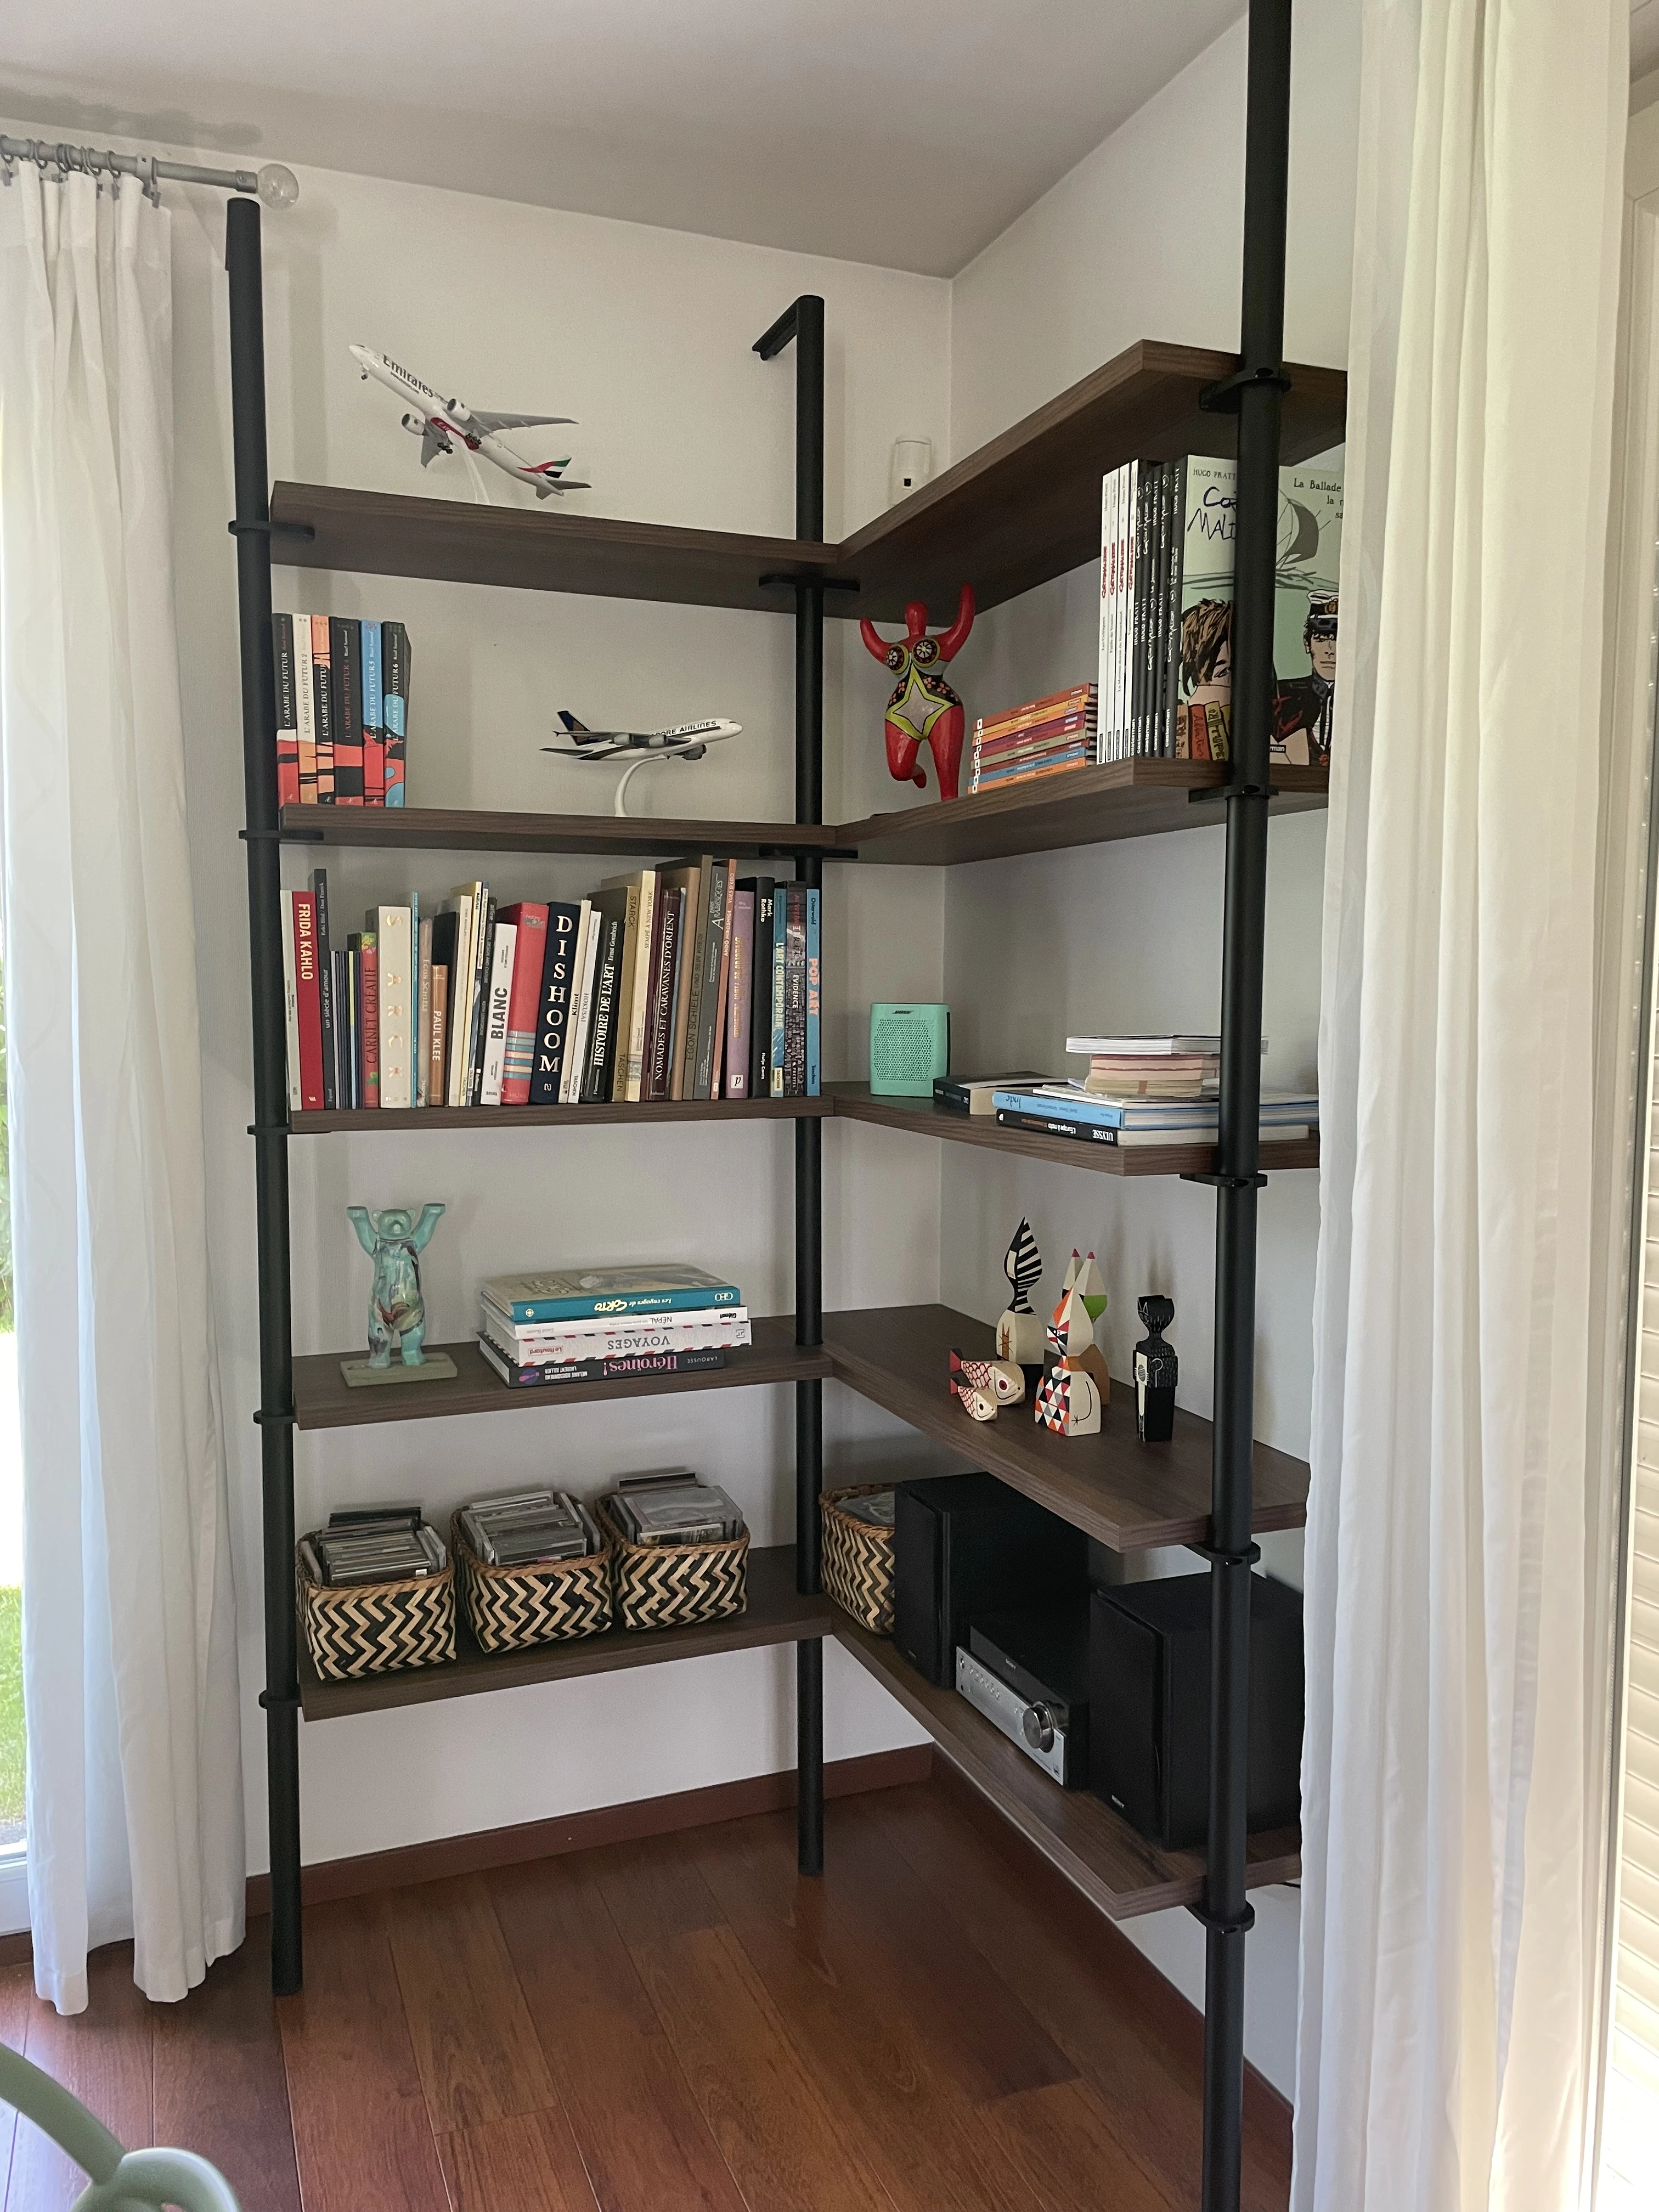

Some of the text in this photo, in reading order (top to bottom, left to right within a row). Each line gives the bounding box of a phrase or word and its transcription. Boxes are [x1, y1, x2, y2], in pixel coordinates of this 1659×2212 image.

[383, 354, 433, 398] Emirates
[1193, 469, 1211, 477] HUGO
[1294, 478, 1341, 492] La Ballade
[1327, 495, 1334, 505] la
[283, 682, 289, 693] DU
[302, 689, 309, 699] DU
[320, 690, 328, 701] DU
[369, 696, 376, 706] DU
[680, 721, 716, 732] AIRLINES
[628, 895, 636, 928] STARCK
[298, 904, 313, 980] FRIDA KAHLO
[538, 915, 573, 1073] DISHOOM
[809, 958, 819, 1015] POP ART
[655, 910, 674, 1080] NOMADES ET CARAVANES D'ORIENT
[581, 993, 589, 1022] HOKUSAI
[600, 996, 611, 1012] DE
[689, 990, 699, 1030] SCHIELE
[490, 988, 507, 1040] BLANC
[325, 1019, 330, 1029] un
[365, 1018, 377, 1063] CARNET
[432, 1011, 442, 1061] PAUL KLEE
[593, 1014, 608, 1066] HISTOIRE
[686, 1033, 696, 1060] EGON
[617, 1054, 625, 1092] TASCHEN
[1092, 1129, 1113, 1142] ULYSSE
[715, 1292, 733, 1301] GEO
[650, 1316, 672, 1325] NÉPAL
[608, 1335, 670, 1350] VOYAGES
[687, 1356, 718, 1364] LAROUSSE
